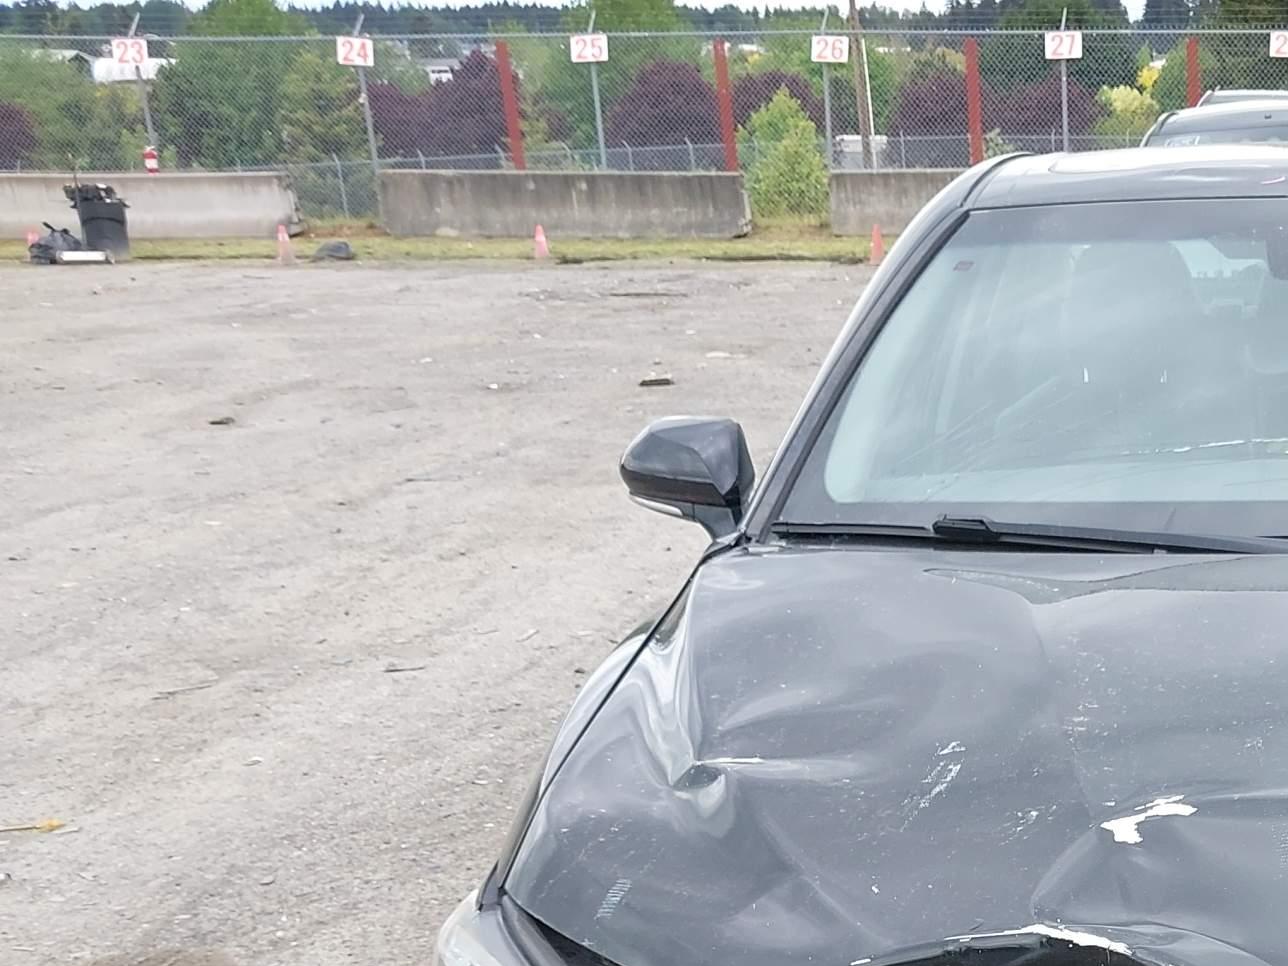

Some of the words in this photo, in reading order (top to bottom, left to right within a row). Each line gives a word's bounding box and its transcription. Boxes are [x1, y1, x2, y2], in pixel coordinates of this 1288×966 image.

[116, 41, 144, 64] 23
[342, 40, 370, 63] 24
[575, 38, 603, 60] 25
[815, 38, 844, 60] 26
[1050, 34, 1076, 57] 27
